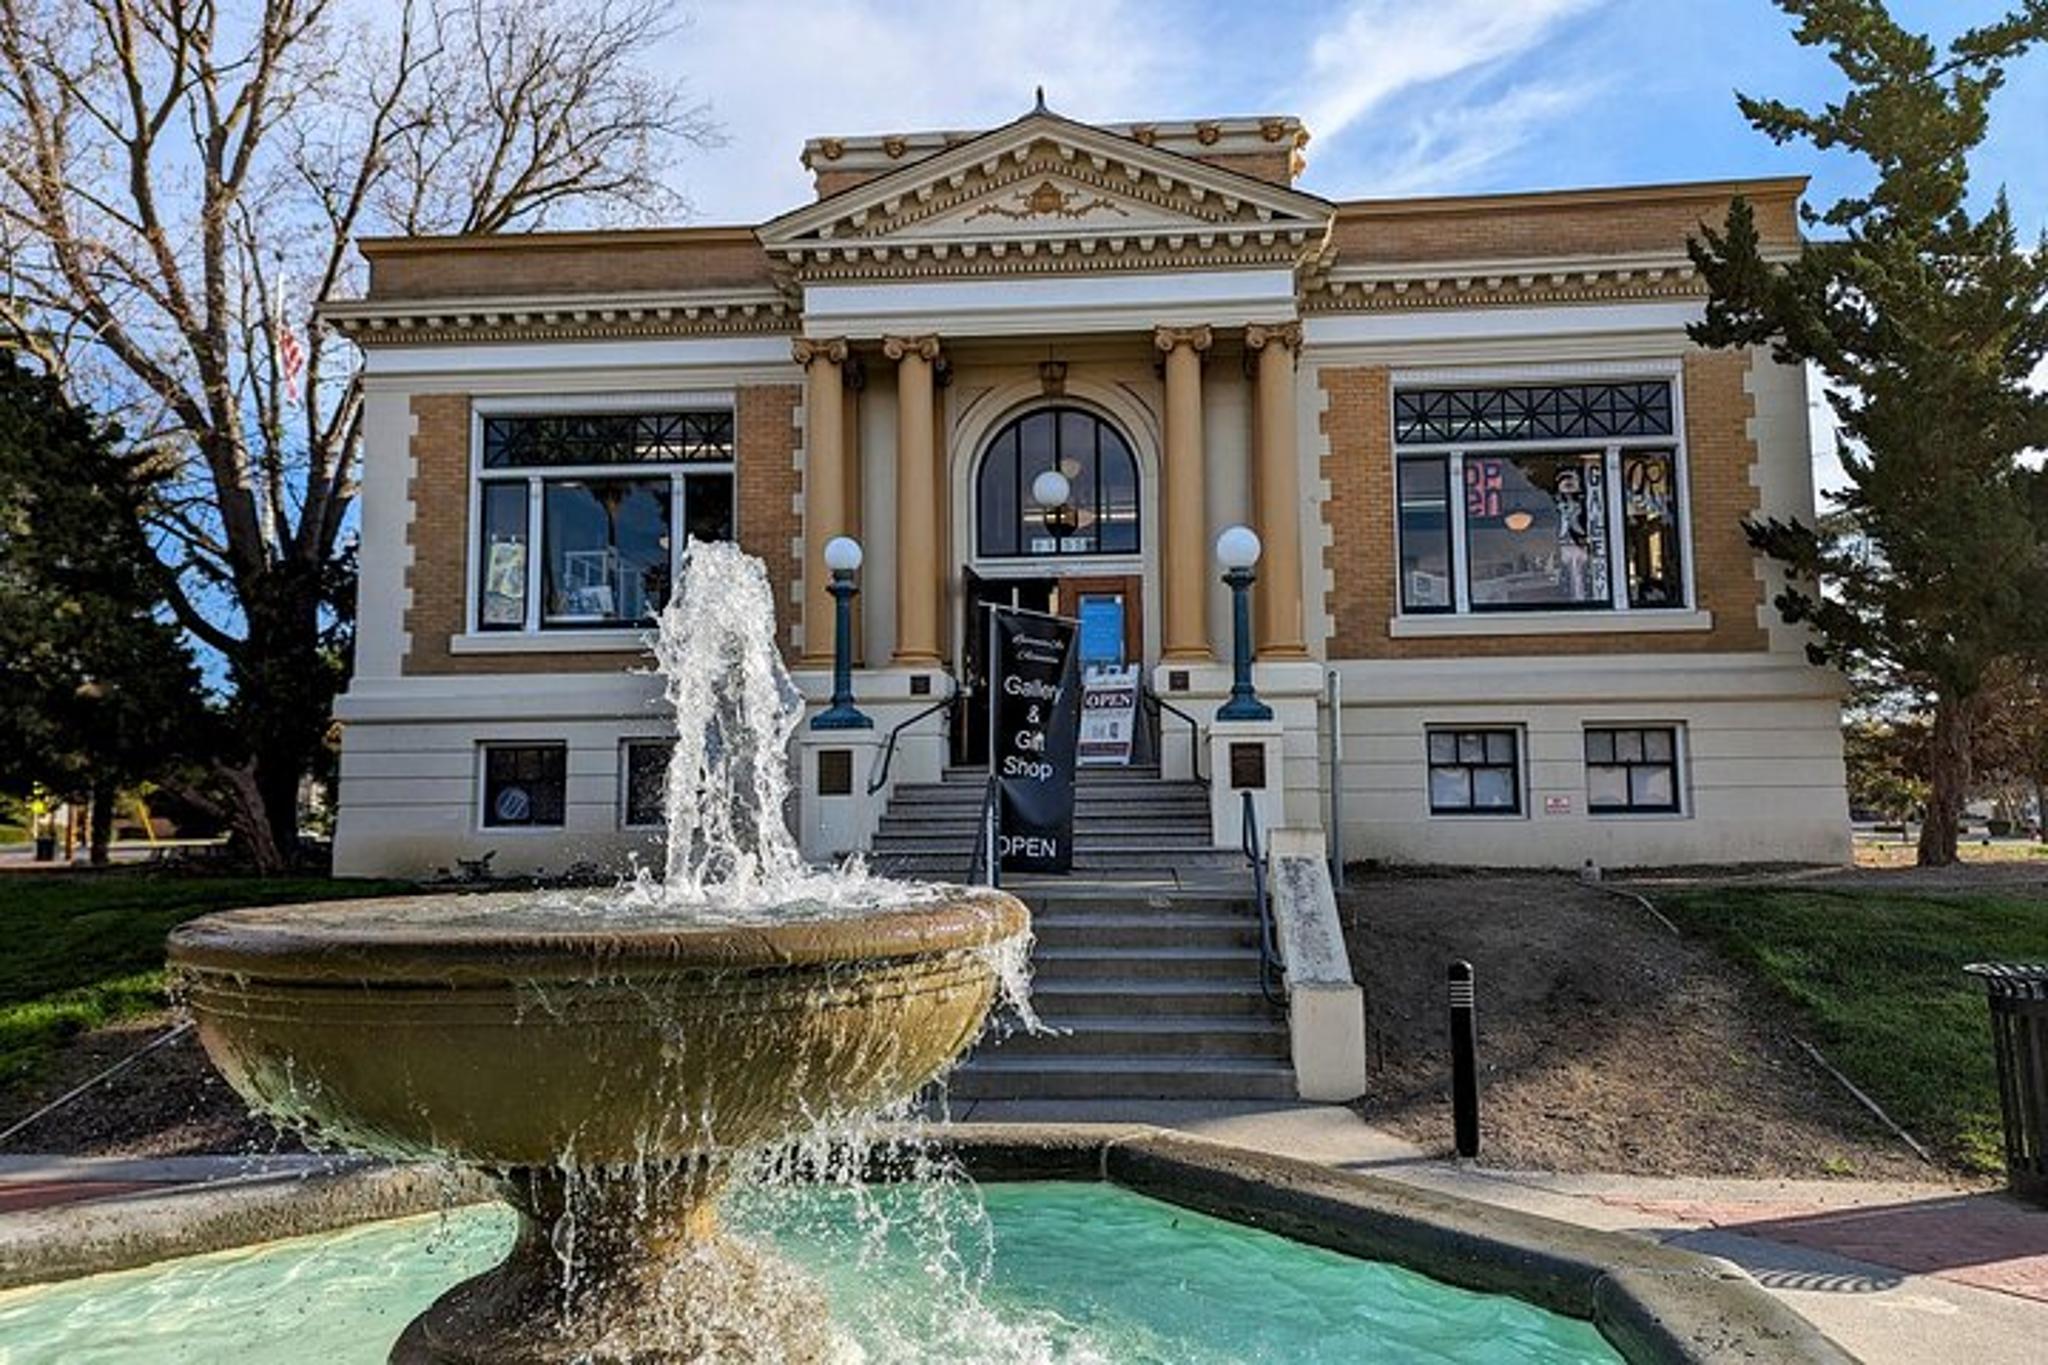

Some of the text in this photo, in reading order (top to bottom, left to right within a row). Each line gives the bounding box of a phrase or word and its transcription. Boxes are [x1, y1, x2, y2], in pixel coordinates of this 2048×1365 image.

[1086, 692, 1131, 708] OPEN
[1026, 704, 1039, 723] &
[1003, 755, 1054, 779] Shop
[998, 835, 1057, 859] OPEN
